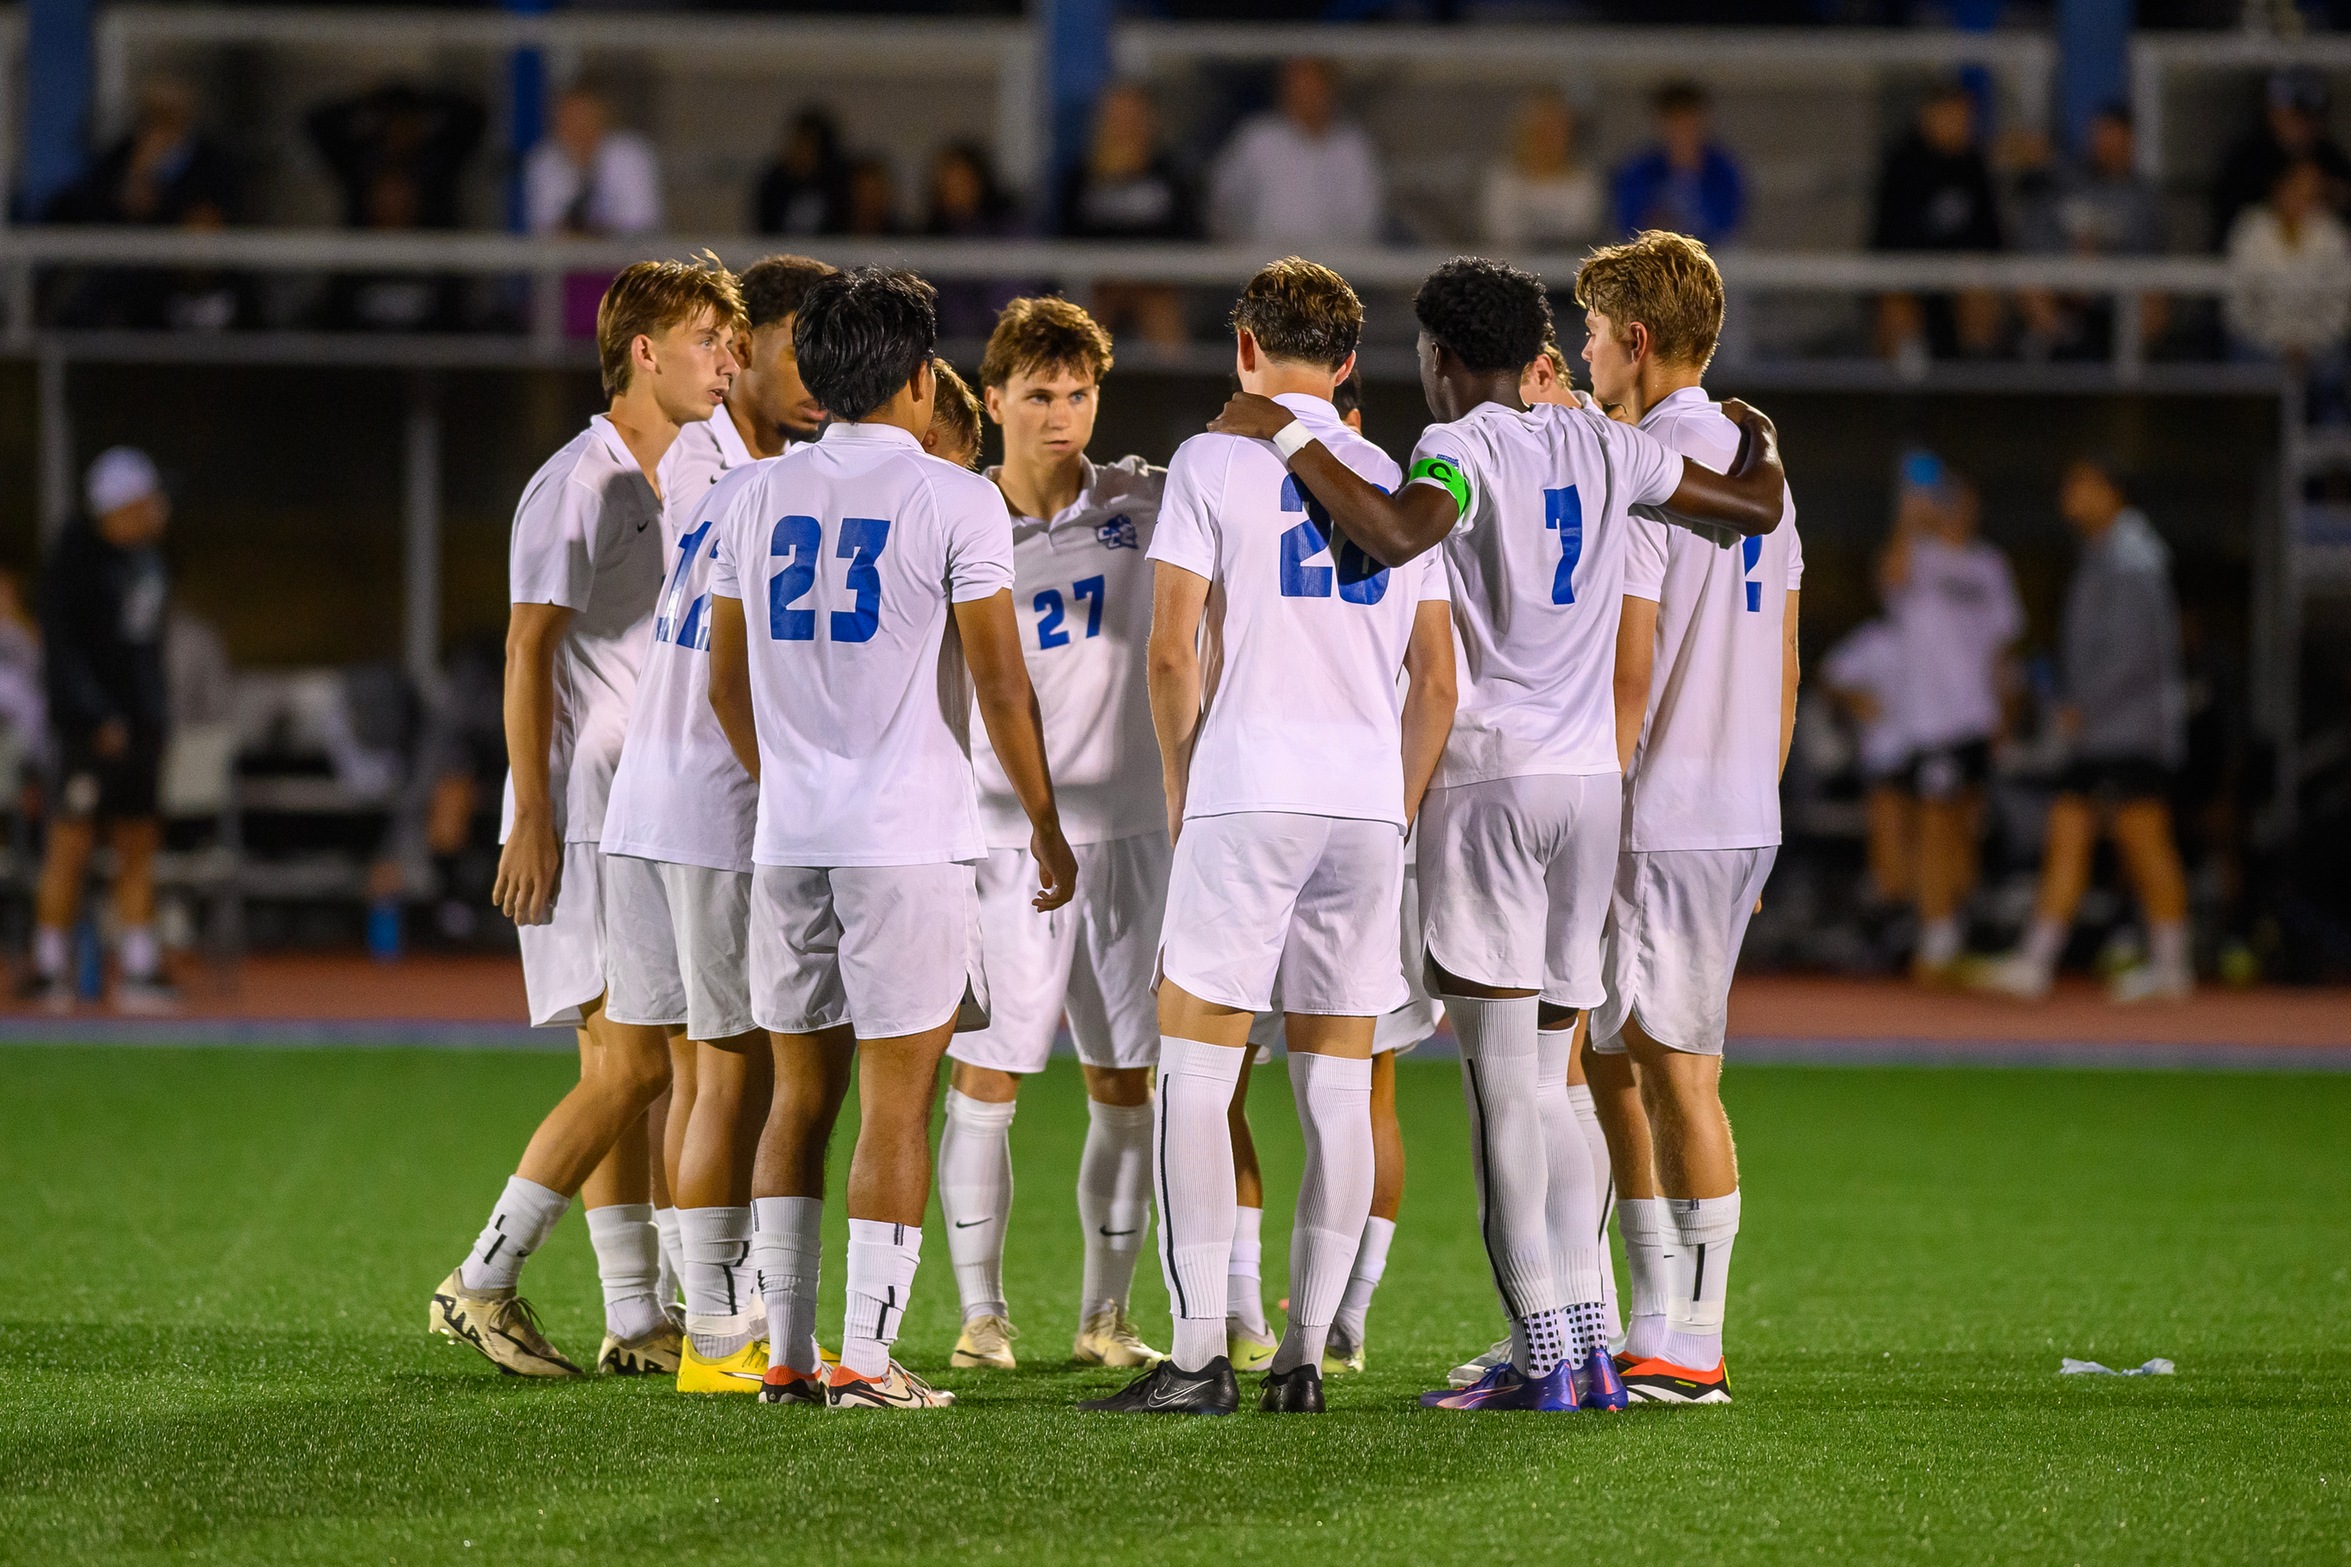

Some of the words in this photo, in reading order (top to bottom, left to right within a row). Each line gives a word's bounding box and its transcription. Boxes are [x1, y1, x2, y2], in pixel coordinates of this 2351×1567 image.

[770, 515, 891, 642] 23
[1543, 484, 1582, 605] 7
[1033, 573, 1105, 651] 27
